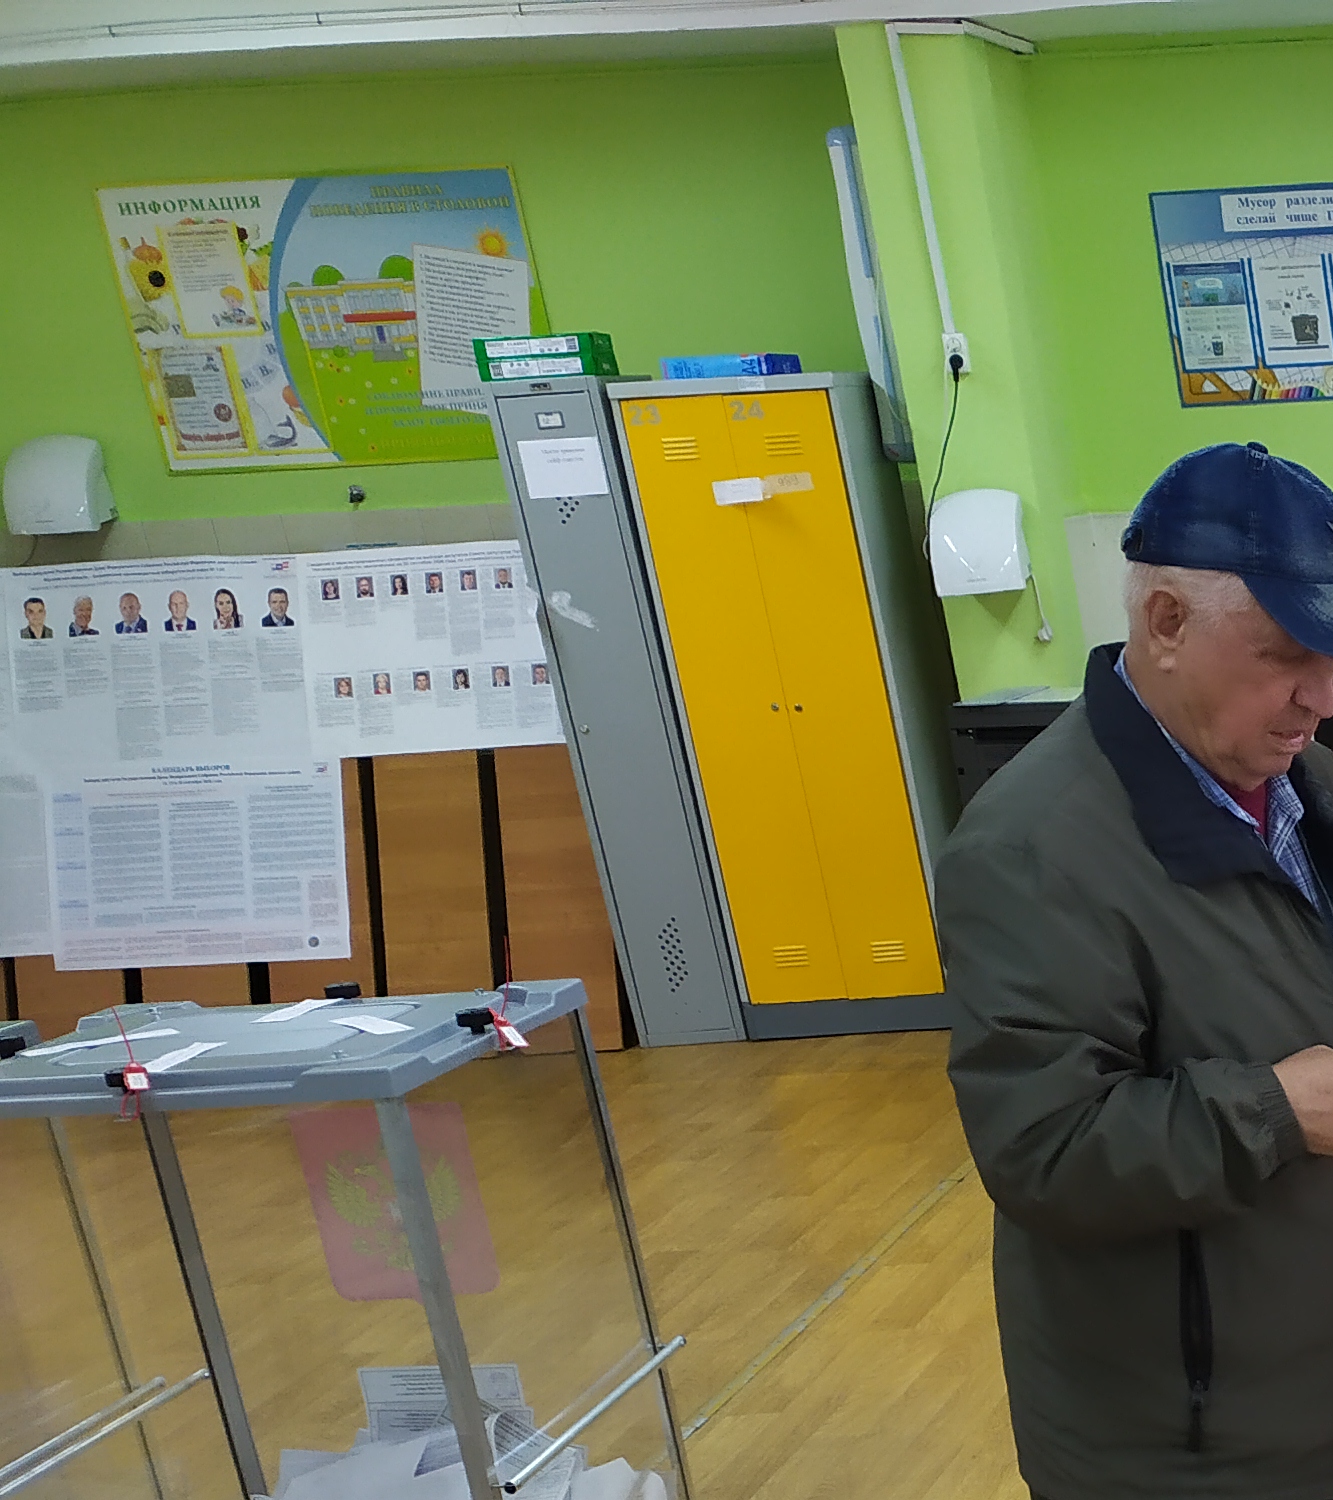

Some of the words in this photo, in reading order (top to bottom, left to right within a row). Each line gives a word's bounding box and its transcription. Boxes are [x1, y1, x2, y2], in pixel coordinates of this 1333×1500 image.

[370, 184, 443, 198] ПРАВИЛА
[118, 195, 261, 216] ИНФОРМАЦИЯ
[1237, 197, 1276, 210] Мусор
[1286, 195, 1333, 208] раздели
[1236, 213, 1277, 225] сделай
[1286, 213, 1318, 223] чище
[628, 405, 662, 425] 23
[728, 400, 765, 421] 24
